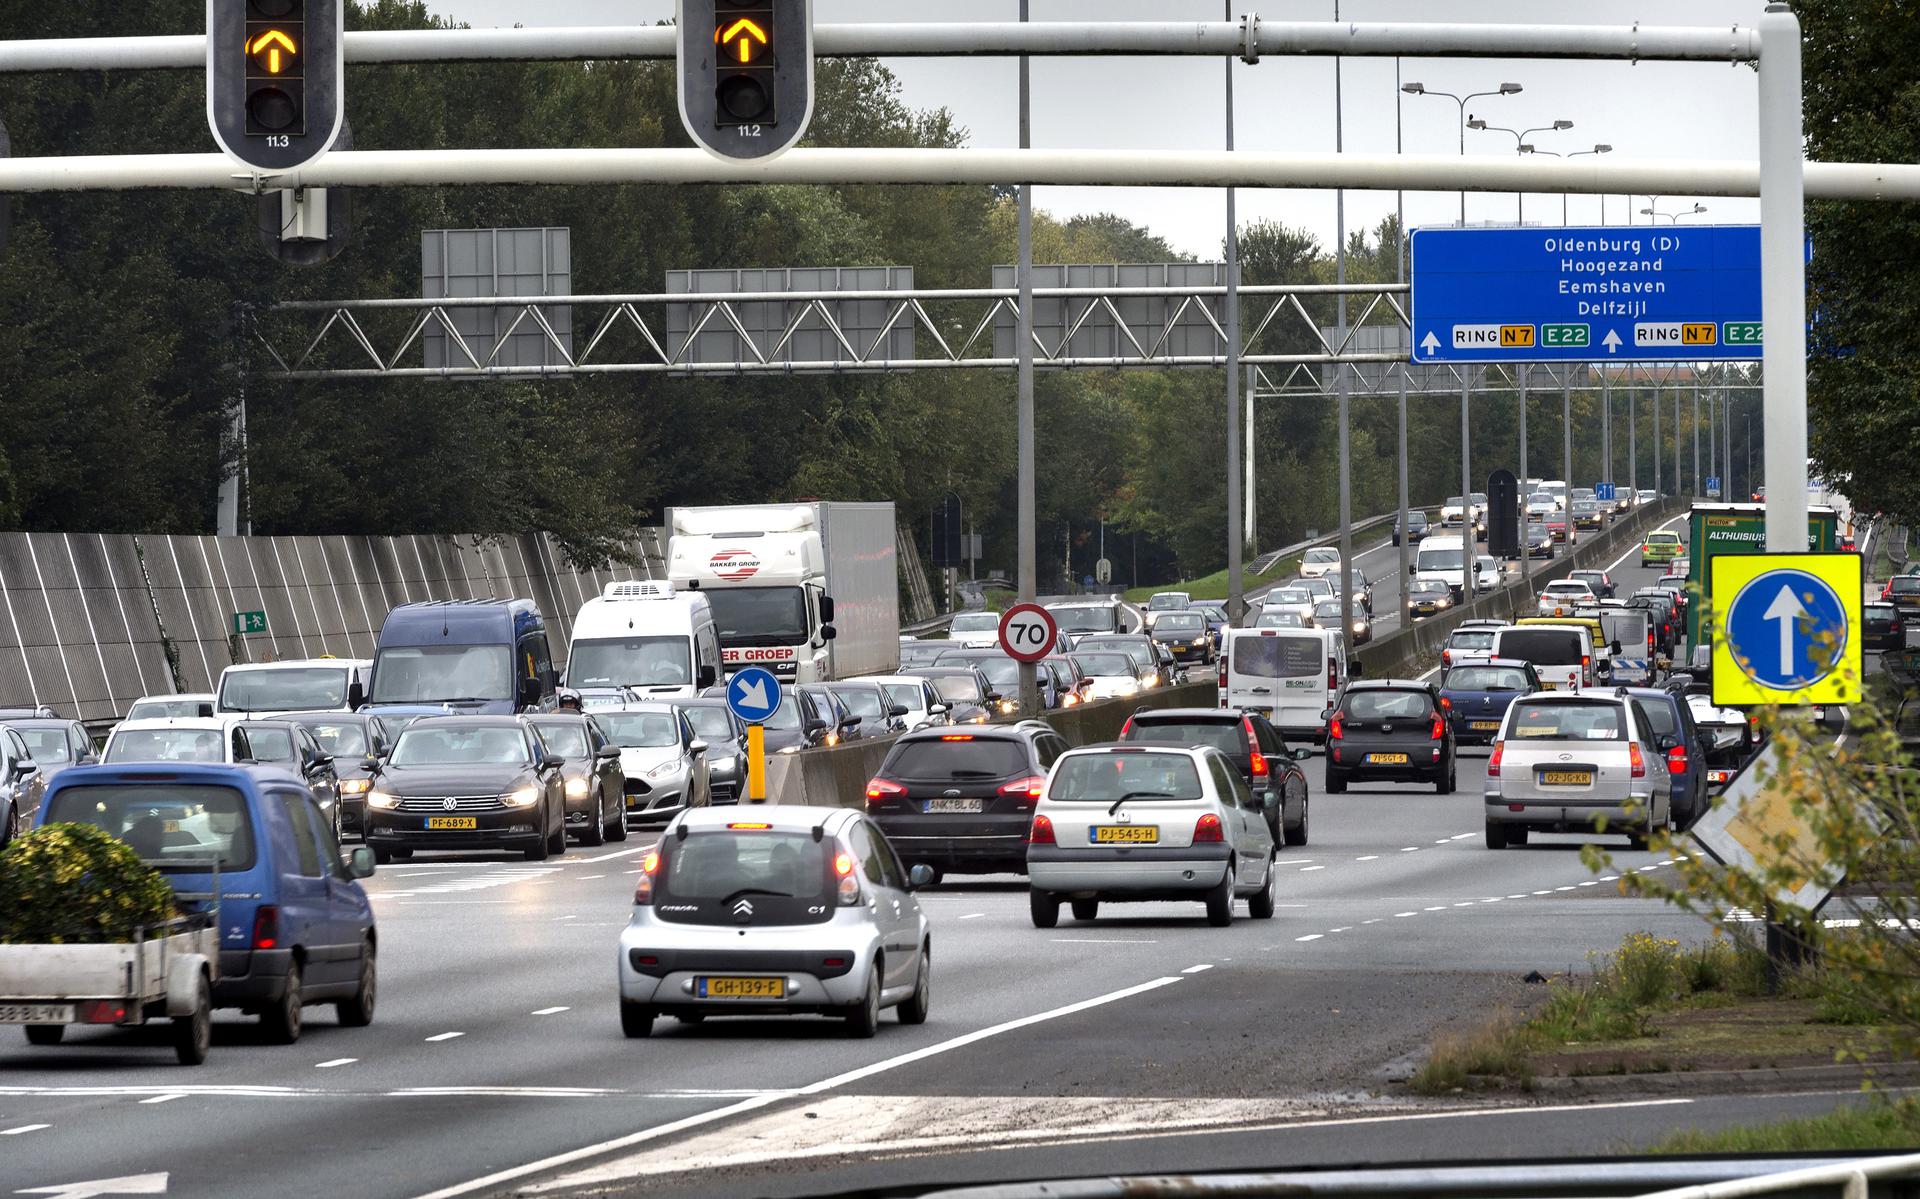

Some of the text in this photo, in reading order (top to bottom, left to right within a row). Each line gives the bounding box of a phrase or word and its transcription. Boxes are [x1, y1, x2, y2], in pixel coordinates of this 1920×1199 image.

[738, 124, 761, 137] 11.2
[266, 135, 289, 147] 11.3
[1545, 236, 1680, 255] Oldenburg (D)
[1561, 258, 1663, 276] Hoogezand
[1559, 280, 1666, 294] Eemshaven
[1578, 301, 1647, 319] Delfzijl
[1456, 330, 1497, 343] RING
[1547, 329, 1586, 342] E22
[1637, 328, 1679, 341] RING
[1010, 624, 1045, 645] 70
[745, 649, 793, 660] GROEP
[1547, 773, 1588, 783] 02-JG-KR
[432, 818, 473, 828] PF-689-X
[1101, 829, 1153, 839] PJ-545-H
[808, 905, 826, 914] C1
[714, 980, 777, 994] GH-139-F
